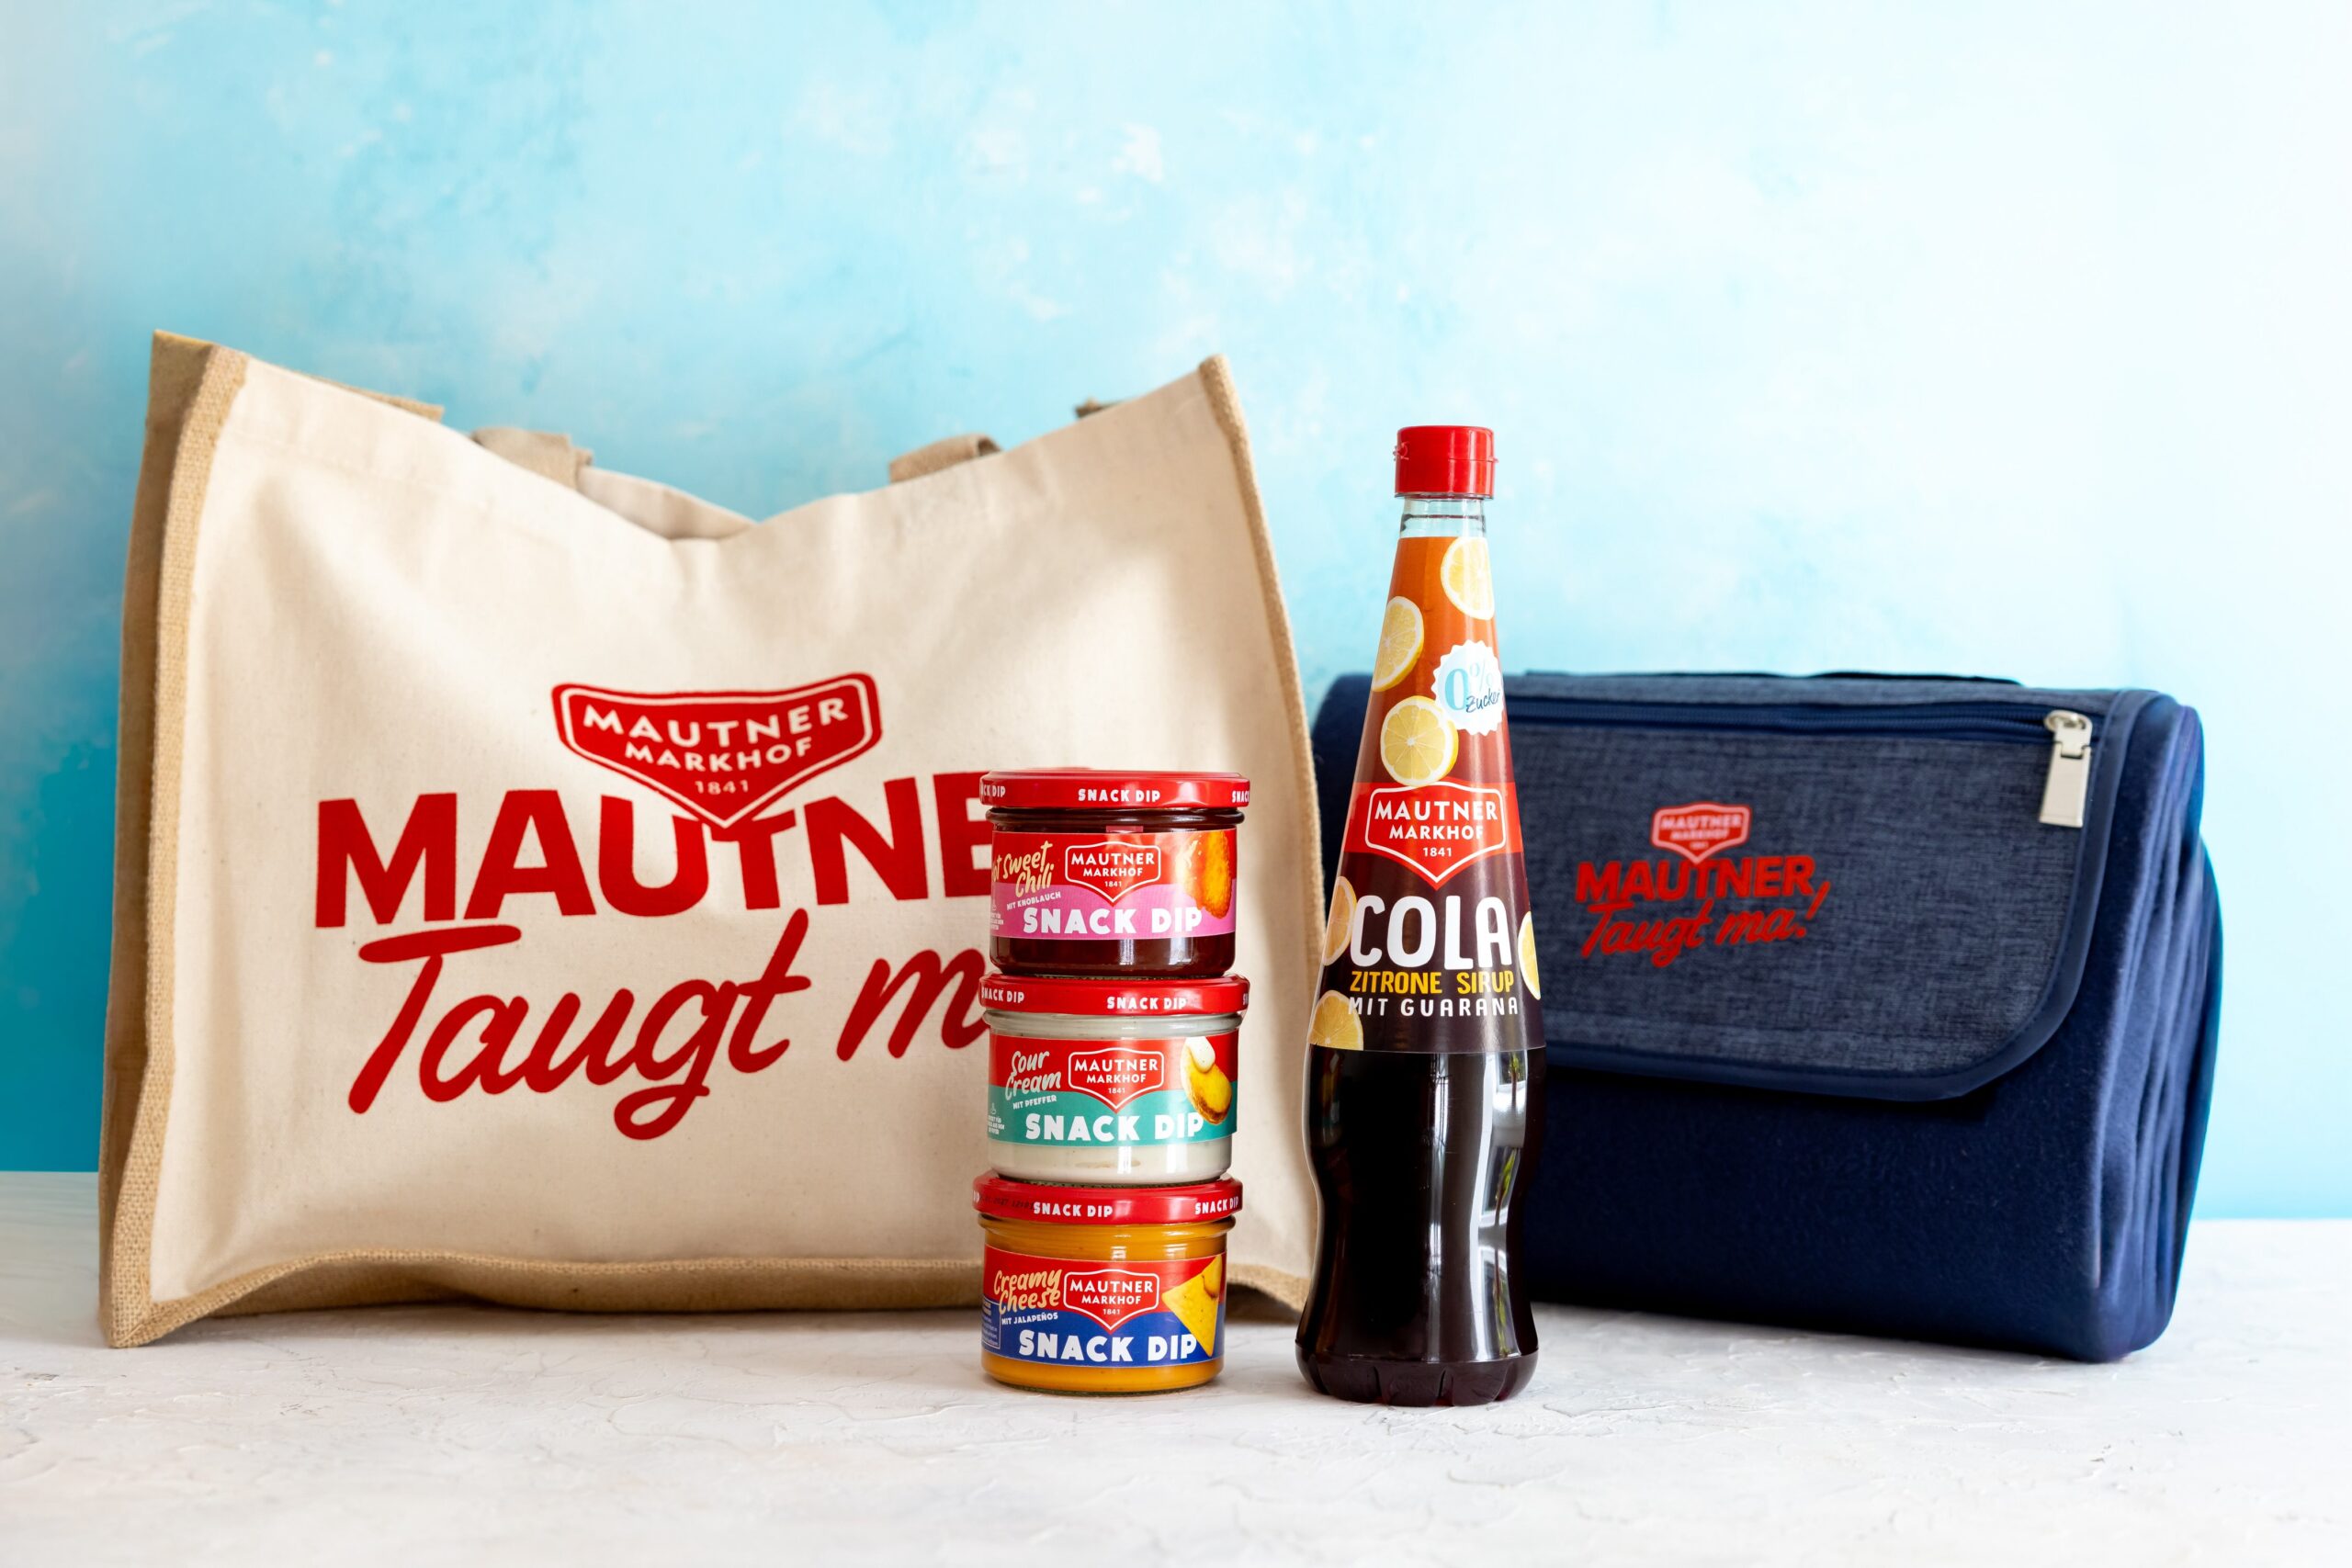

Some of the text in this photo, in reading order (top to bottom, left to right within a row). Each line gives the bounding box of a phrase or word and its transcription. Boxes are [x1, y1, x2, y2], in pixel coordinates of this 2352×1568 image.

[1465, 687, 1501, 714] Zucker
[582, 697, 848, 748] MAUTNER
[625, 736, 812, 773] MARKHOF
[695, 779, 750, 795] 1841
[992, 784, 1006, 797] DIP
[1078, 788, 1160, 803] SNACK DIP
[1374, 800, 1498, 821] MAUTNER
[1389, 826, 1484, 840] MARKHOF
[315, 771, 991, 928] MAUTNE
[1070, 852, 1156, 867] MAUTNER
[1423, 847, 1453, 857] 1841
[1002, 840, 1054, 880] Sweet
[1015, 863, 1055, 898] Chili
[1082, 866, 1144, 877] MARKHOF
[1103, 880, 1123, 888] 1841
[1006, 891, 1061, 911] MIT KNOBLAUCH
[1023, 907, 1137, 935] SNACK
[1151, 906, 1203, 934] DIP
[1350, 895, 1512, 971] COLA
[1580, 897, 1713, 967] Taugt
[1350, 969, 1515, 995] ZITRONE SIRUP
[981, 986, 1025, 1004] SNACK DIP
[1107, 996, 1187, 1010] SNACK DIP
[1348, 997, 1519, 1018] MIT GUARANA
[347, 908, 812, 1141] Taugt
[1010, 1050, 1050, 1077] Sour
[1074, 1058, 1159, 1073] MAUTNER
[1005, 1071, 1062, 1101] Cream
[1086, 1073, 1147, 1084] MARKHOF
[1108, 1087, 1125, 1095] 1841
[1012, 1094, 1057, 1110] MIT PFEFFER
[1025, 1112, 1140, 1142] SNACK
[1154, 1113, 1204, 1141] DIP
[1033, 1201, 1082, 1217] SNACK
[1087, 1204, 1114, 1218] DIP
[1194, 1195, 1239, 1215] SNACK DIP
[993, 1269, 1063, 1295] Creamy
[1069, 1280, 1154, 1293] MAUTNER
[999, 1283, 1061, 1315] Cheese
[1081, 1294, 1142, 1305] MARKHOF
[1001, 1312, 1058, 1325] MIT JALAPEÑOS
[1018, 1329, 1197, 1362] SNACK DIP
